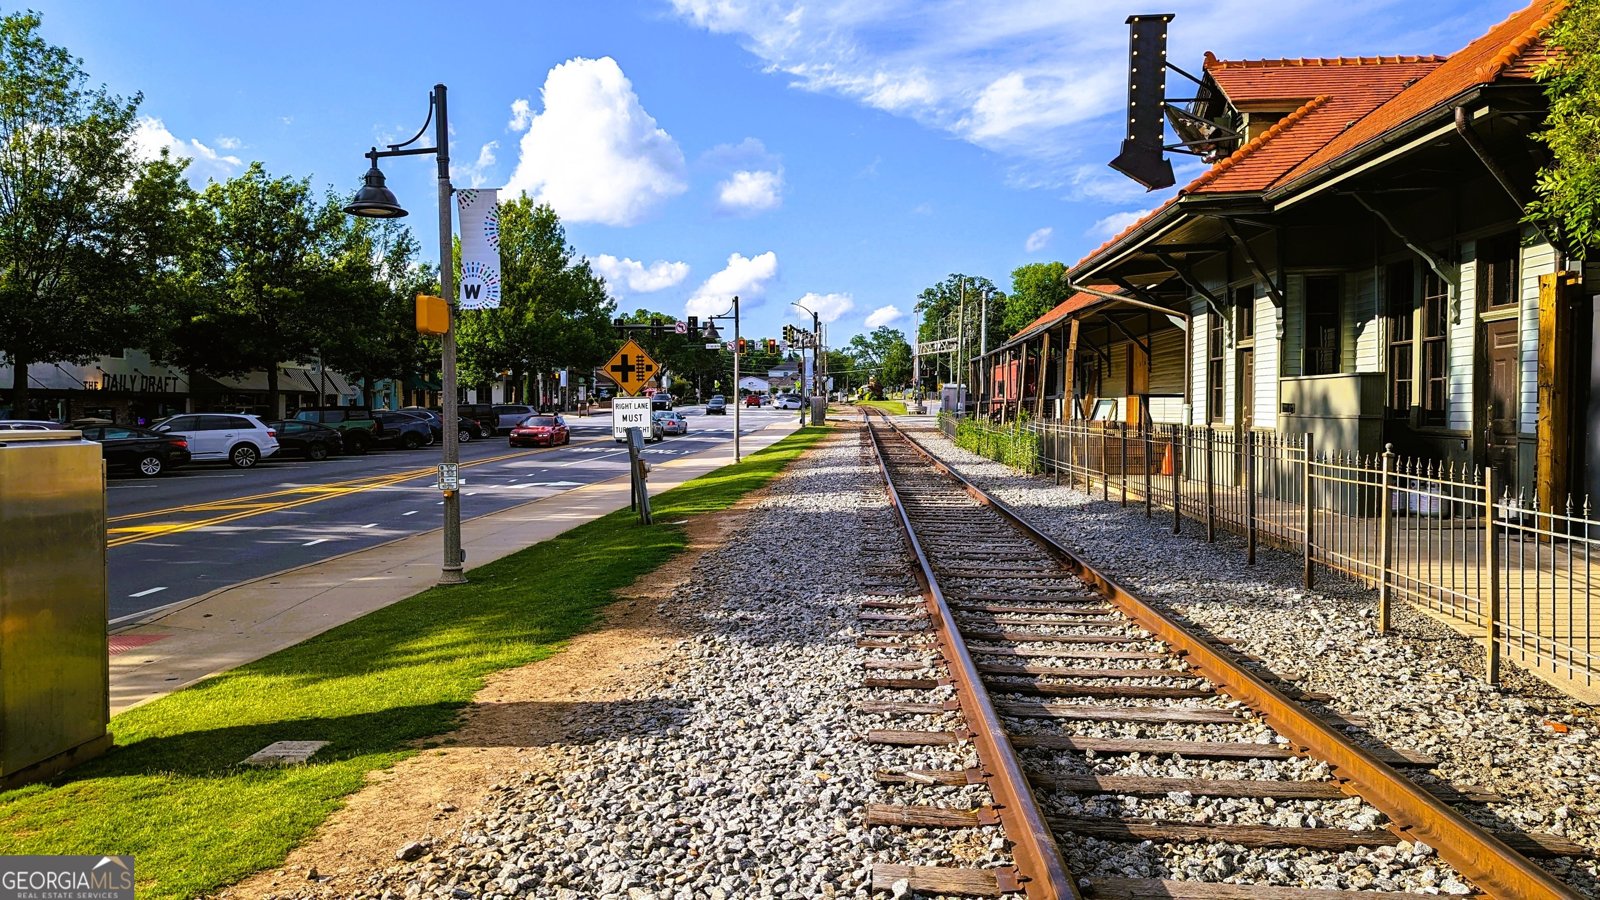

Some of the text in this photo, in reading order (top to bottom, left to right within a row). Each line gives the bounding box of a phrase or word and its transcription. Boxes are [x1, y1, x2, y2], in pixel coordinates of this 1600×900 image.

[464, 284, 481, 299] W
[83, 373, 178, 392] THE DAILY DRAFT
[622, 414, 642, 422] MUST
